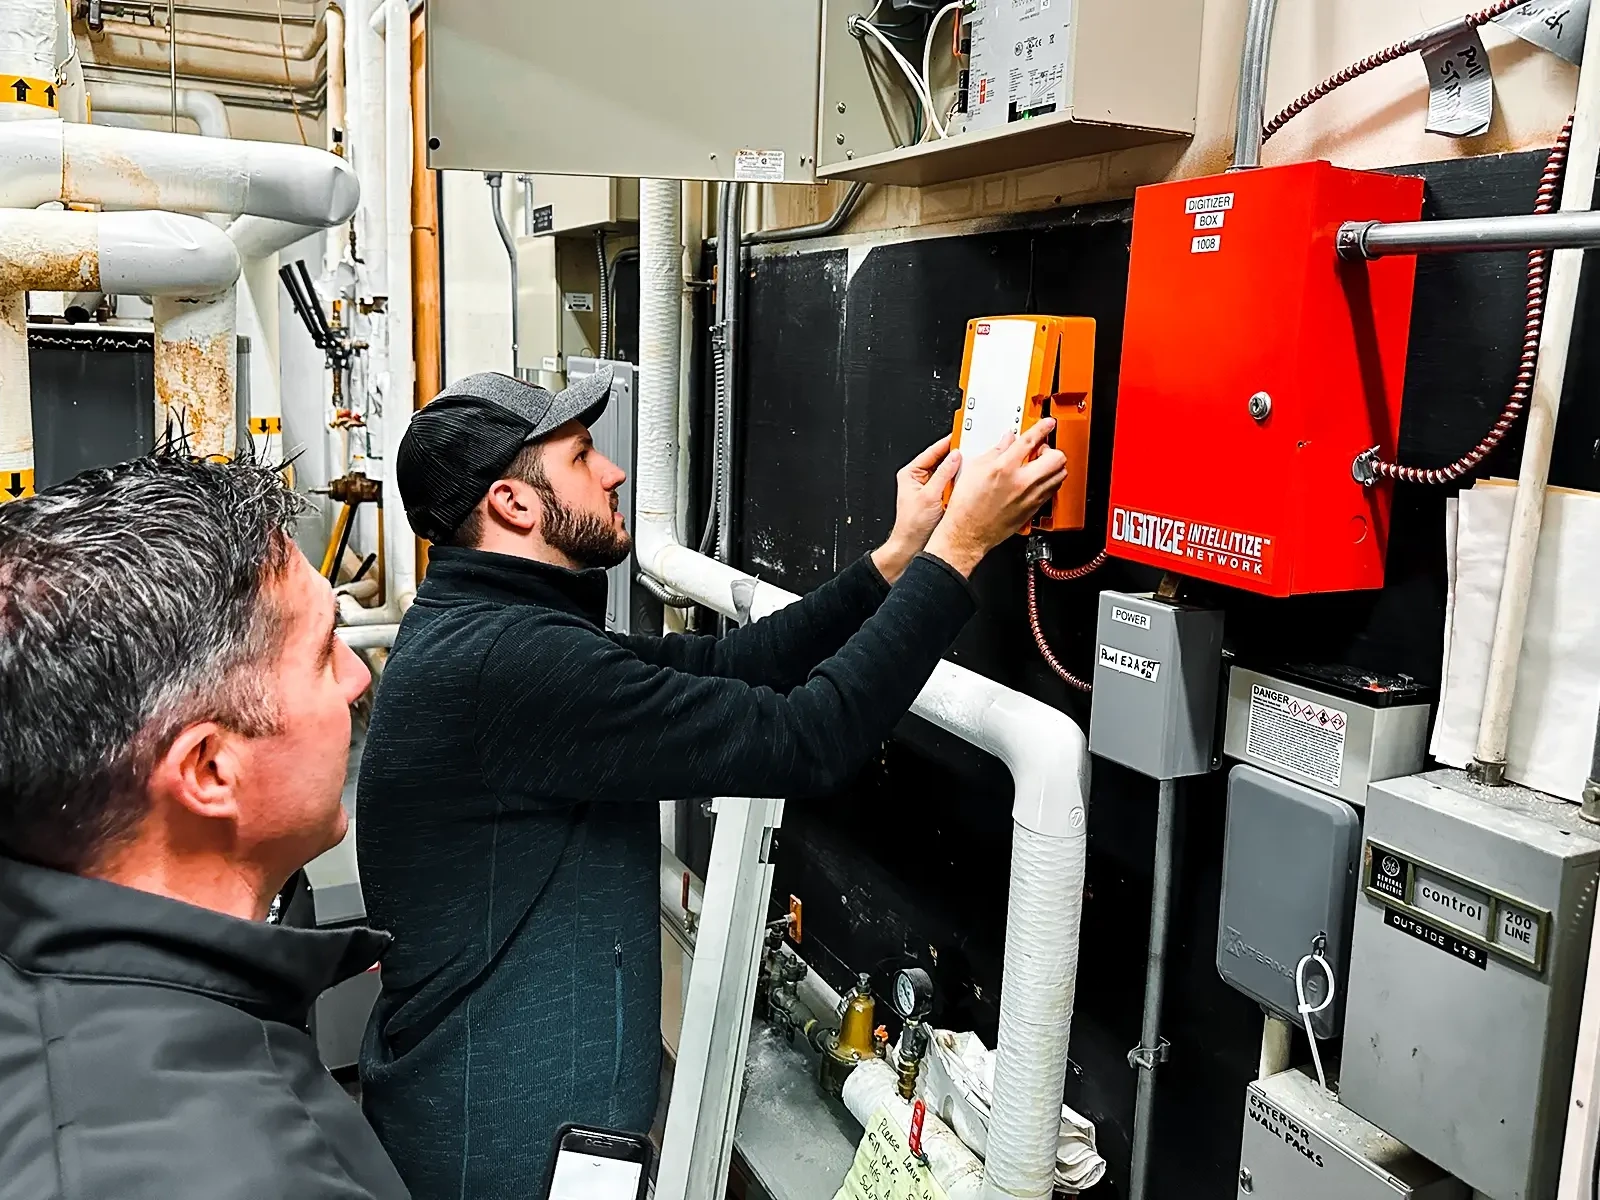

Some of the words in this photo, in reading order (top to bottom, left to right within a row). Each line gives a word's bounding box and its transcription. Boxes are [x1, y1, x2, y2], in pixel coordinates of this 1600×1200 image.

[1188, 196, 1231, 211] DIGITIZER
[1200, 215, 1218, 226] BOX
[1197, 238, 1216, 250] 1008
[1112, 508, 1186, 556] DIGITIZE
[1186, 547, 1262, 575] NETWORK
[1115, 609, 1147, 626] POWER
[1253, 686, 1290, 705] DANGER
[1376, 880, 1402, 896] ELECTRIC
[1377, 873, 1402, 889] GENERAL
[1422, 886, 1482, 921] control
[1505, 910, 1532, 930] 200
[1393, 915, 1445, 946] OUTSIDE
[1453, 942, 1482, 963] LTS.
[1504, 923, 1531, 944] LINE
[1250, 1095, 1309, 1145] EXTERIOR
[1248, 1107, 1282, 1139] WALL
[1285, 1132, 1324, 1168] PACKS
